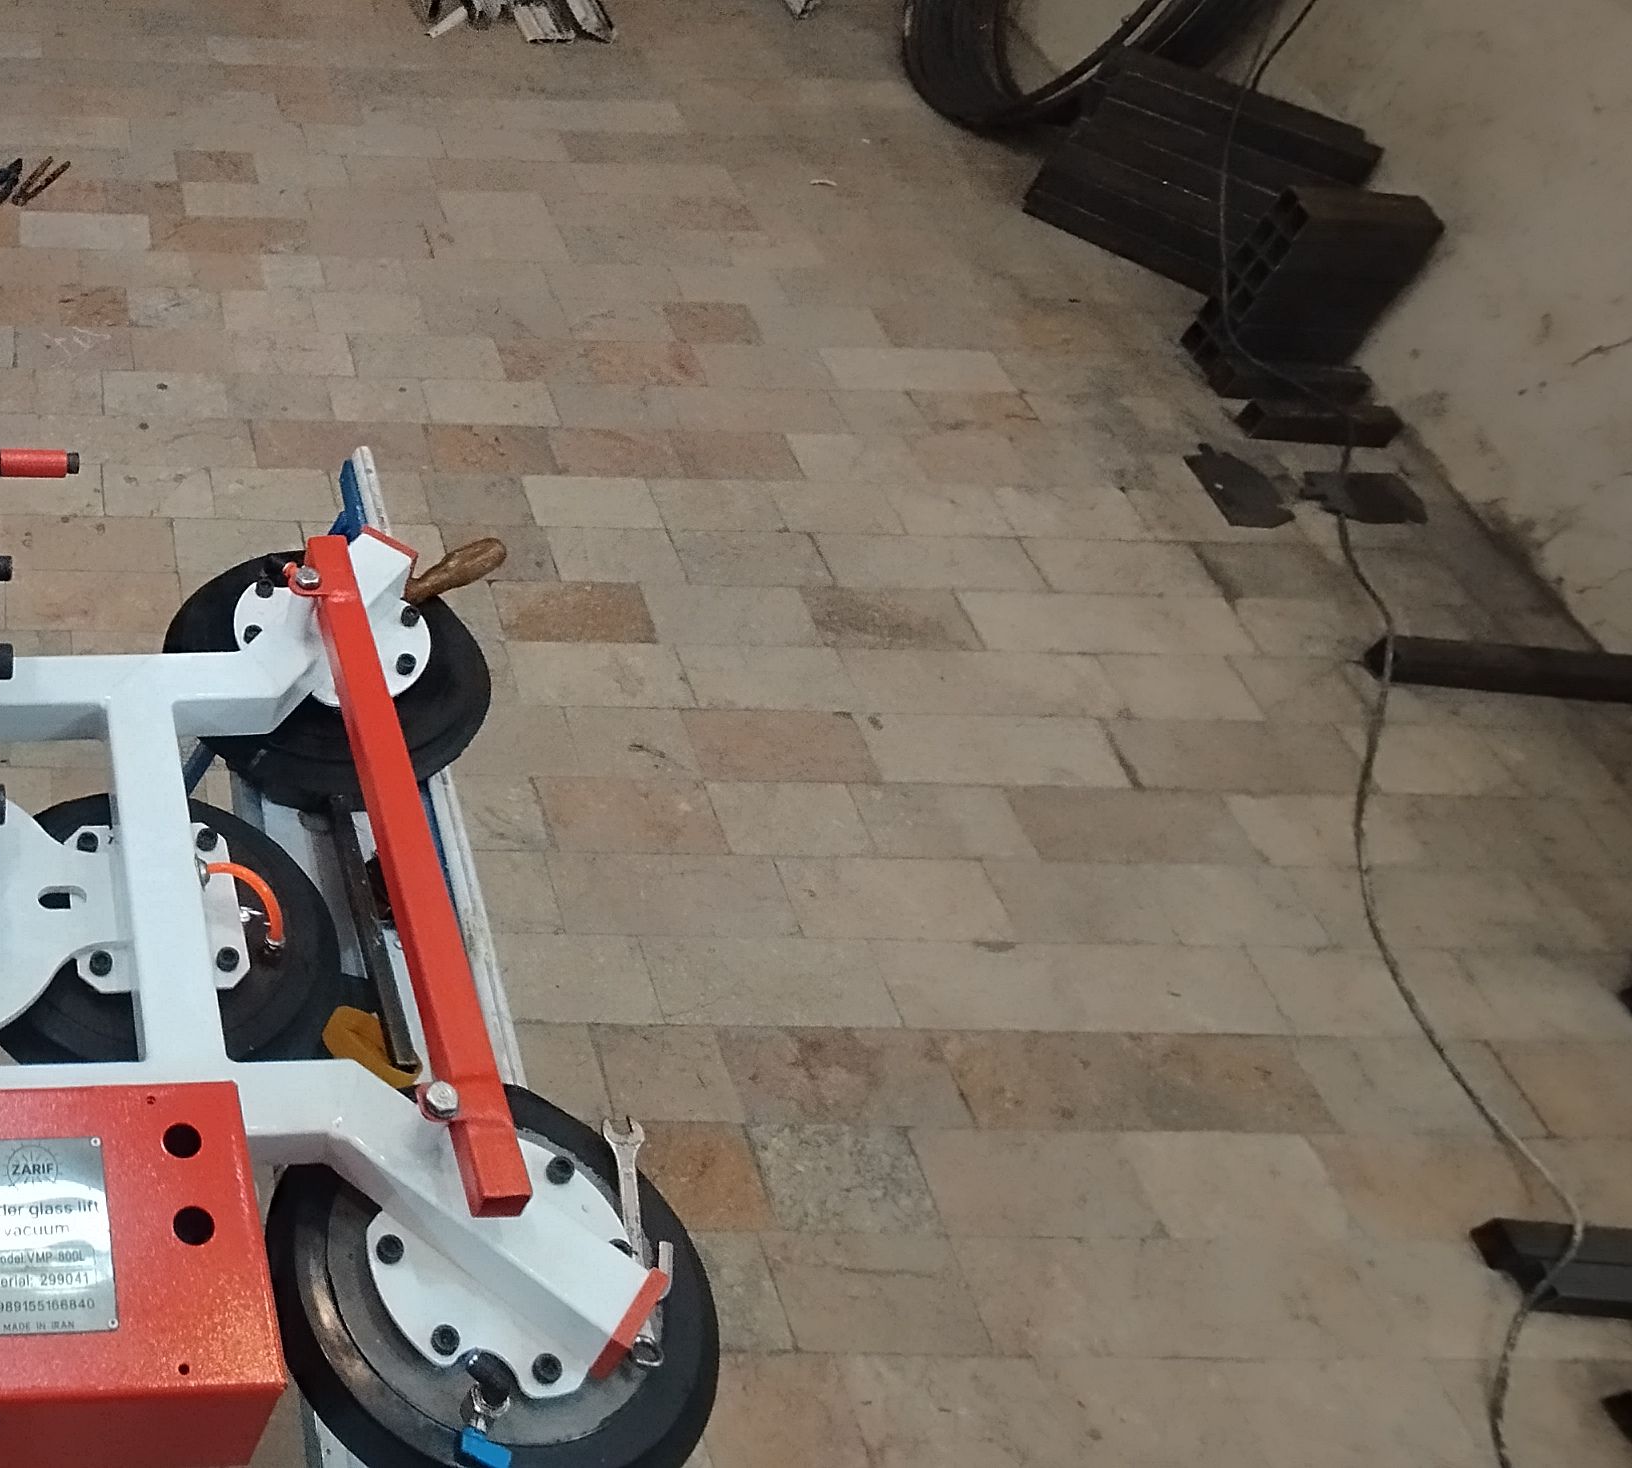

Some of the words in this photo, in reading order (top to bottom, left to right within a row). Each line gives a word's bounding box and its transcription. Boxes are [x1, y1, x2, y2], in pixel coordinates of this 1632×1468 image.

[11, 1162, 55, 1176] ZARIF
[28, 1201, 74, 1219] glass
[77, 1199, 100, 1214] lift
[4, 1223, 70, 1237] vacuum
[39, 1271, 90, 1287] 299041
[3, 1321, 31, 1332] MADE
[35, 1320, 47, 1331] IN
[51, 1320, 76, 1331] IRAN
